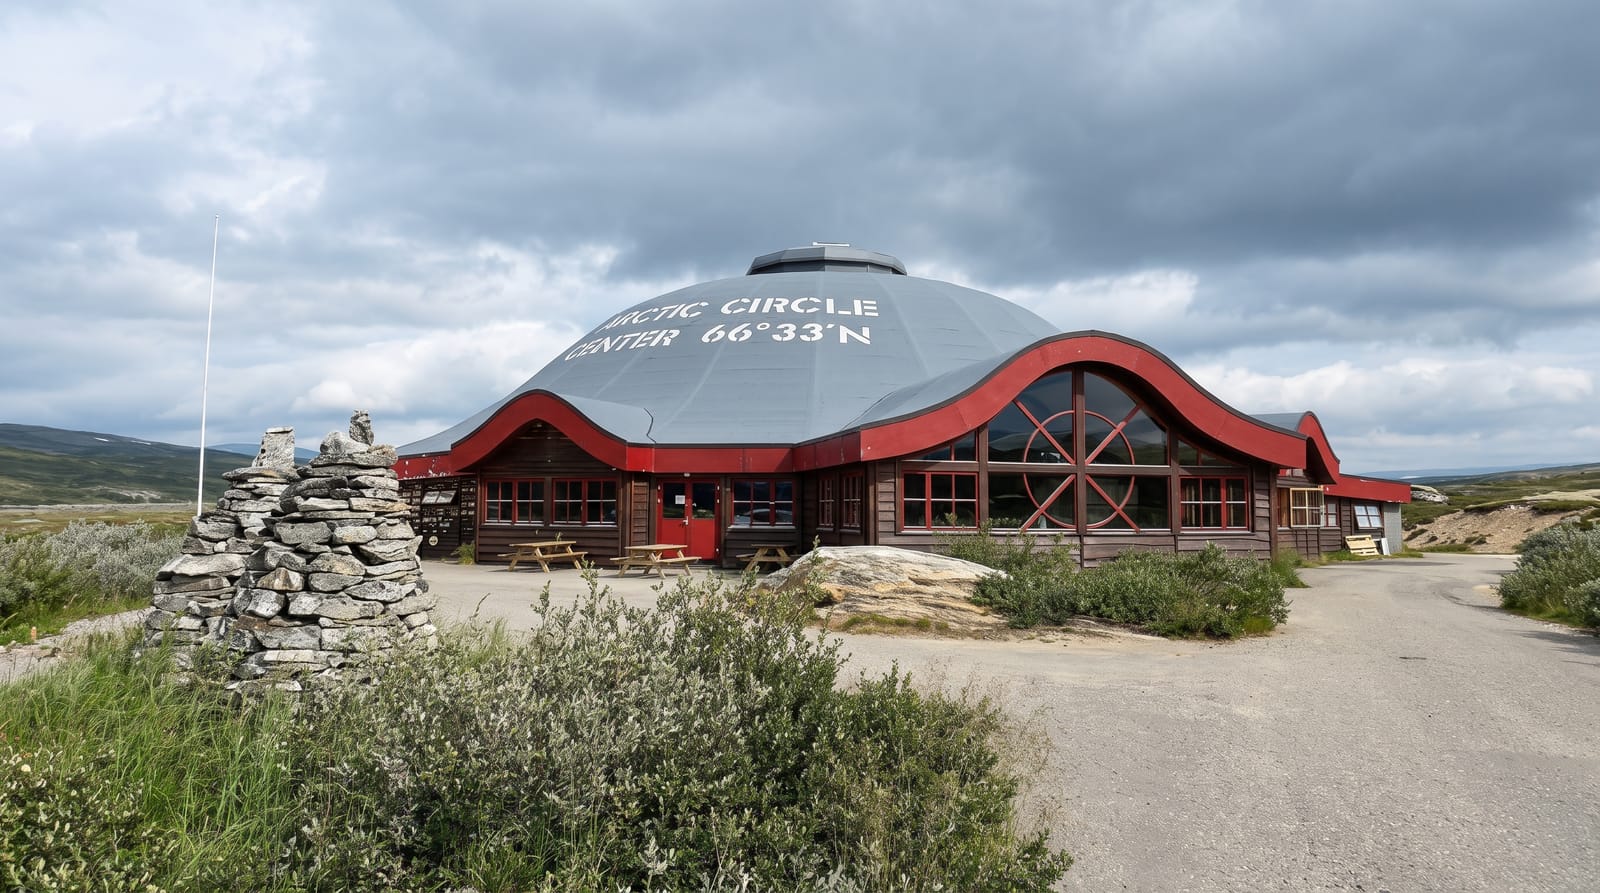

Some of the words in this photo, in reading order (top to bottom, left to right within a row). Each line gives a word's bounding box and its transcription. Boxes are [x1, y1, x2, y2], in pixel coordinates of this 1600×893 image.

[594, 301, 709, 333] ARCTIC
[720, 297, 879, 317] CIRCLE
[565, 329, 680, 361] CENTER
